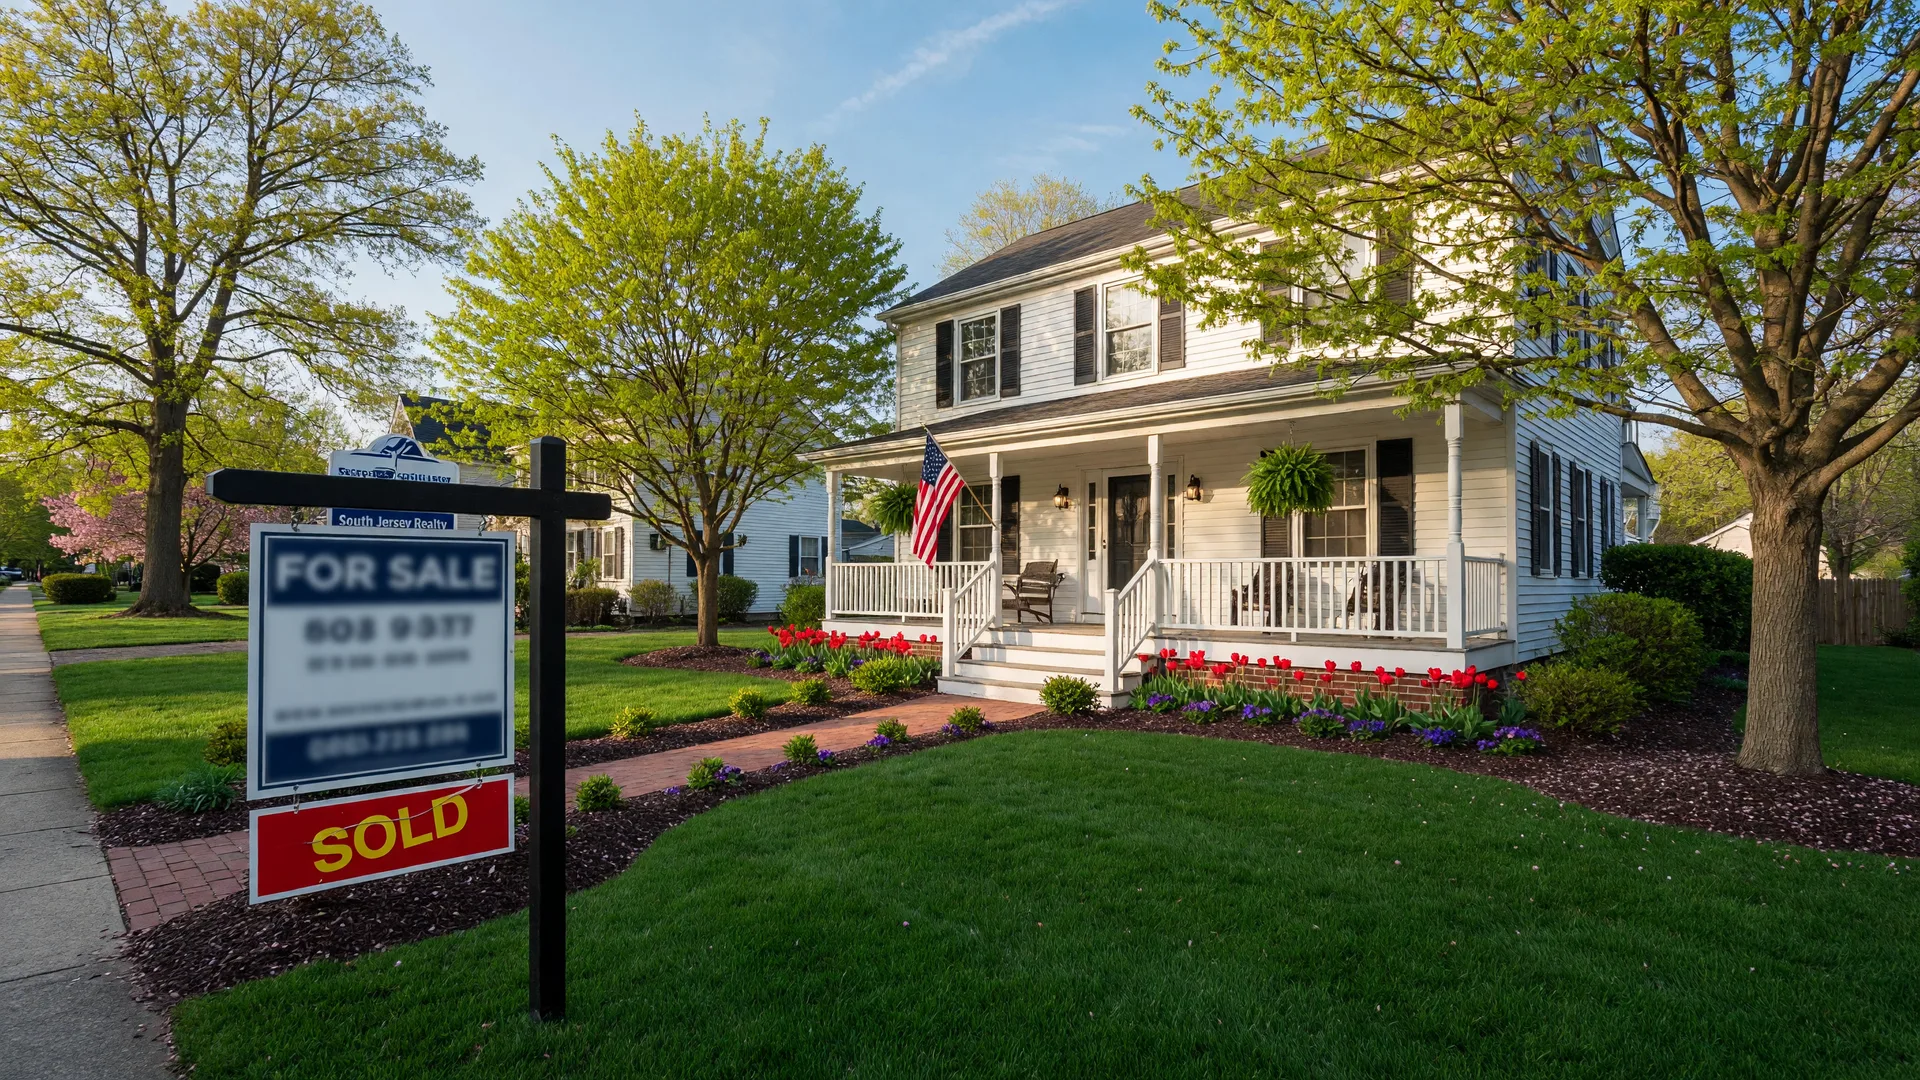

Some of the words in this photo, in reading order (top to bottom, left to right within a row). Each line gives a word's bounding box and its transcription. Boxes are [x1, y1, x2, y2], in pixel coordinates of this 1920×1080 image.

[339, 514, 373, 527] South
[376, 516, 411, 529] Jersey
[414, 517, 448, 530] Realty
[275, 553, 375, 591] FOR
[387, 554, 497, 590] SALE
[311, 794, 469, 874] SOLD
